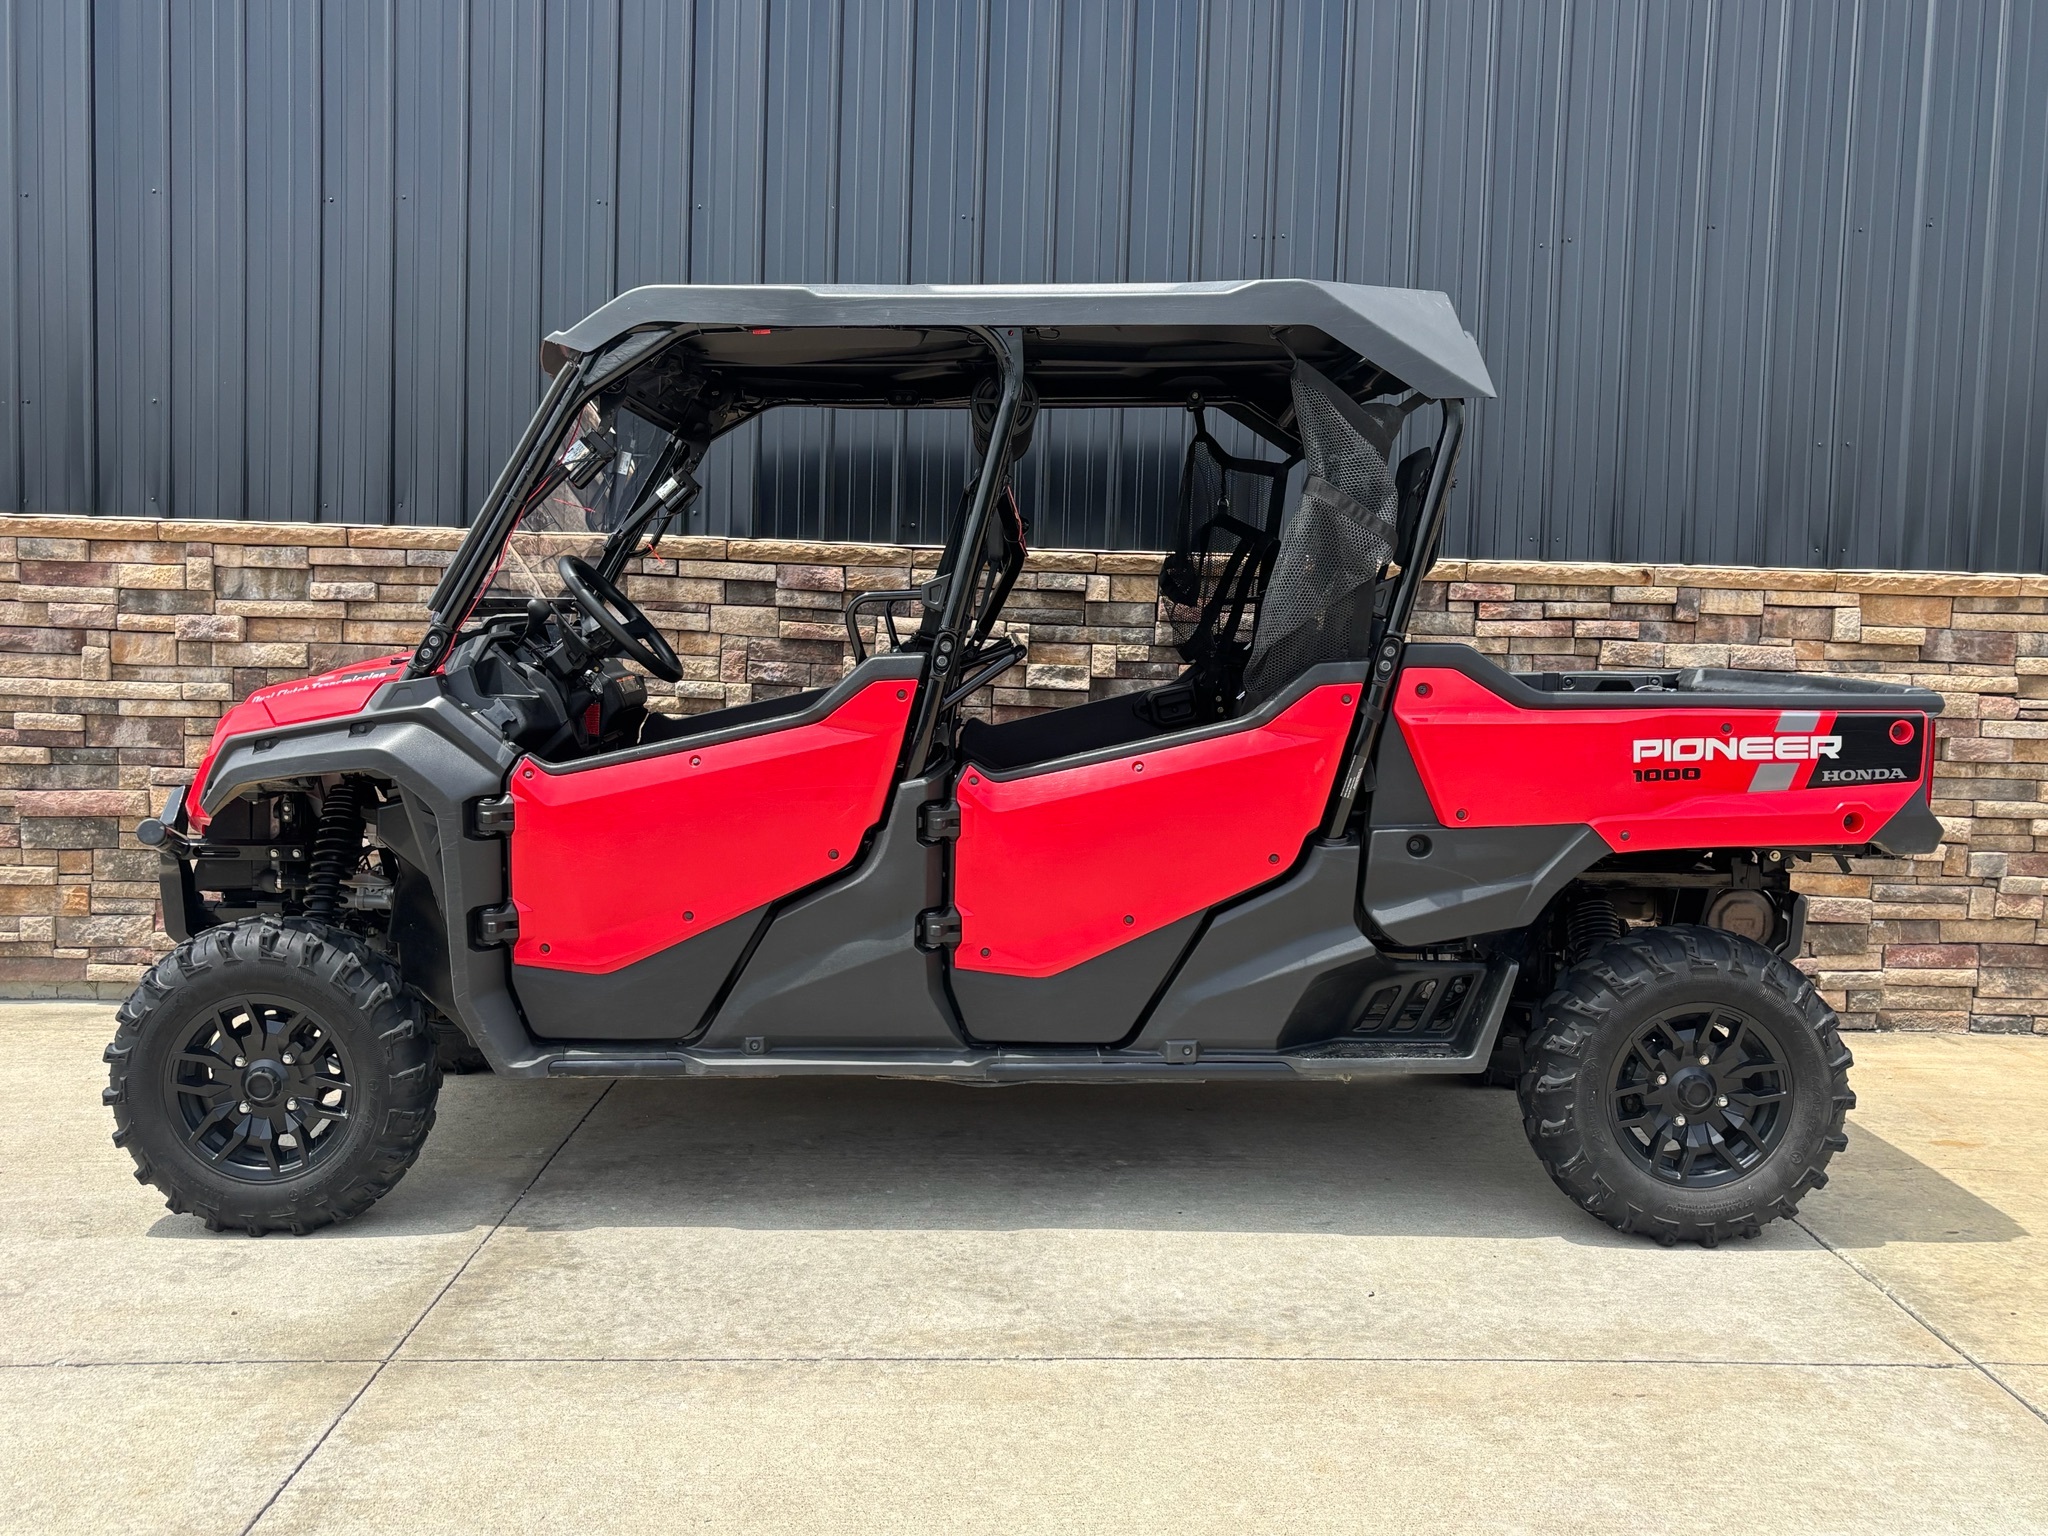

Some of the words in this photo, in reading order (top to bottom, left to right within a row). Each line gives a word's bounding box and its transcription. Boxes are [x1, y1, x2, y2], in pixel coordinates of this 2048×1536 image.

[1633, 736, 1842, 763] PIONEER
[1633, 768, 1701, 782] 1000
[1822, 768, 1907, 782] HONDA
